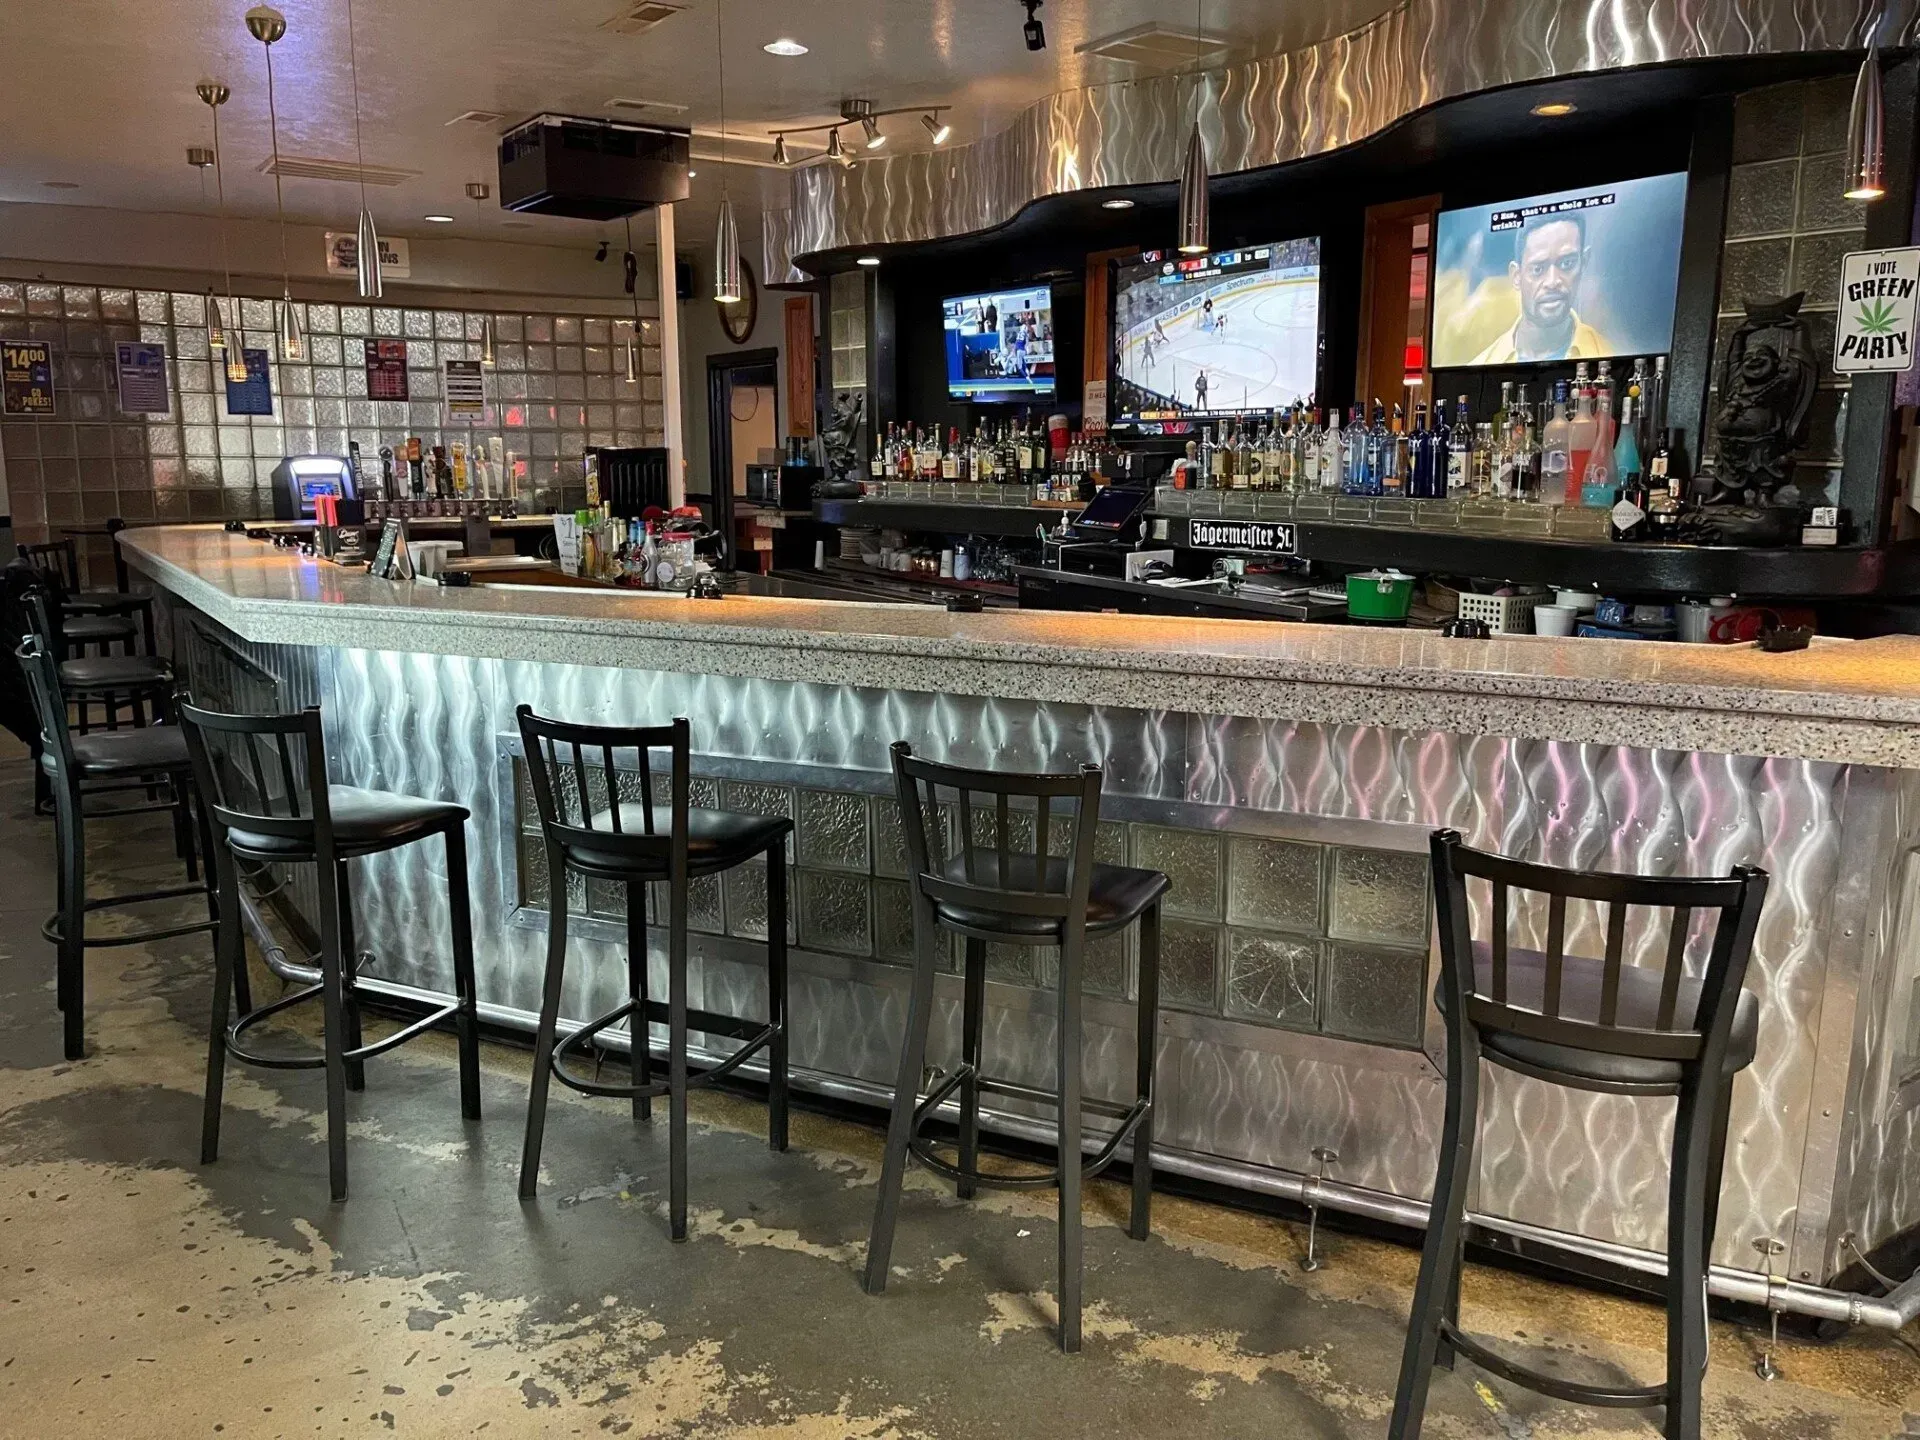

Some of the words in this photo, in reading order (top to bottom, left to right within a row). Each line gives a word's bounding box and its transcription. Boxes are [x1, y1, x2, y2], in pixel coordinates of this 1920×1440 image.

[1521, 207, 1548, 217] that's
[1559, 200, 1582, 211] whole
[1585, 198, 1599, 207] lot
[1602, 195, 1614, 204] of
[1492, 220, 1523, 231] wrinkly
[1867, 263, 1872, 276] I
[1874, 261, 1897, 276] VOTE
[1847, 277, 1916, 302] GREEN
[1839, 331, 1908, 360] PARTY
[22, 396, 52, 407] POKES!
[31, 388, 42, 397] GO
[352, 449, 362, 472] LIGHT
[355, 471, 364, 489] BUD
[1276, 526, 1293, 550] St.
